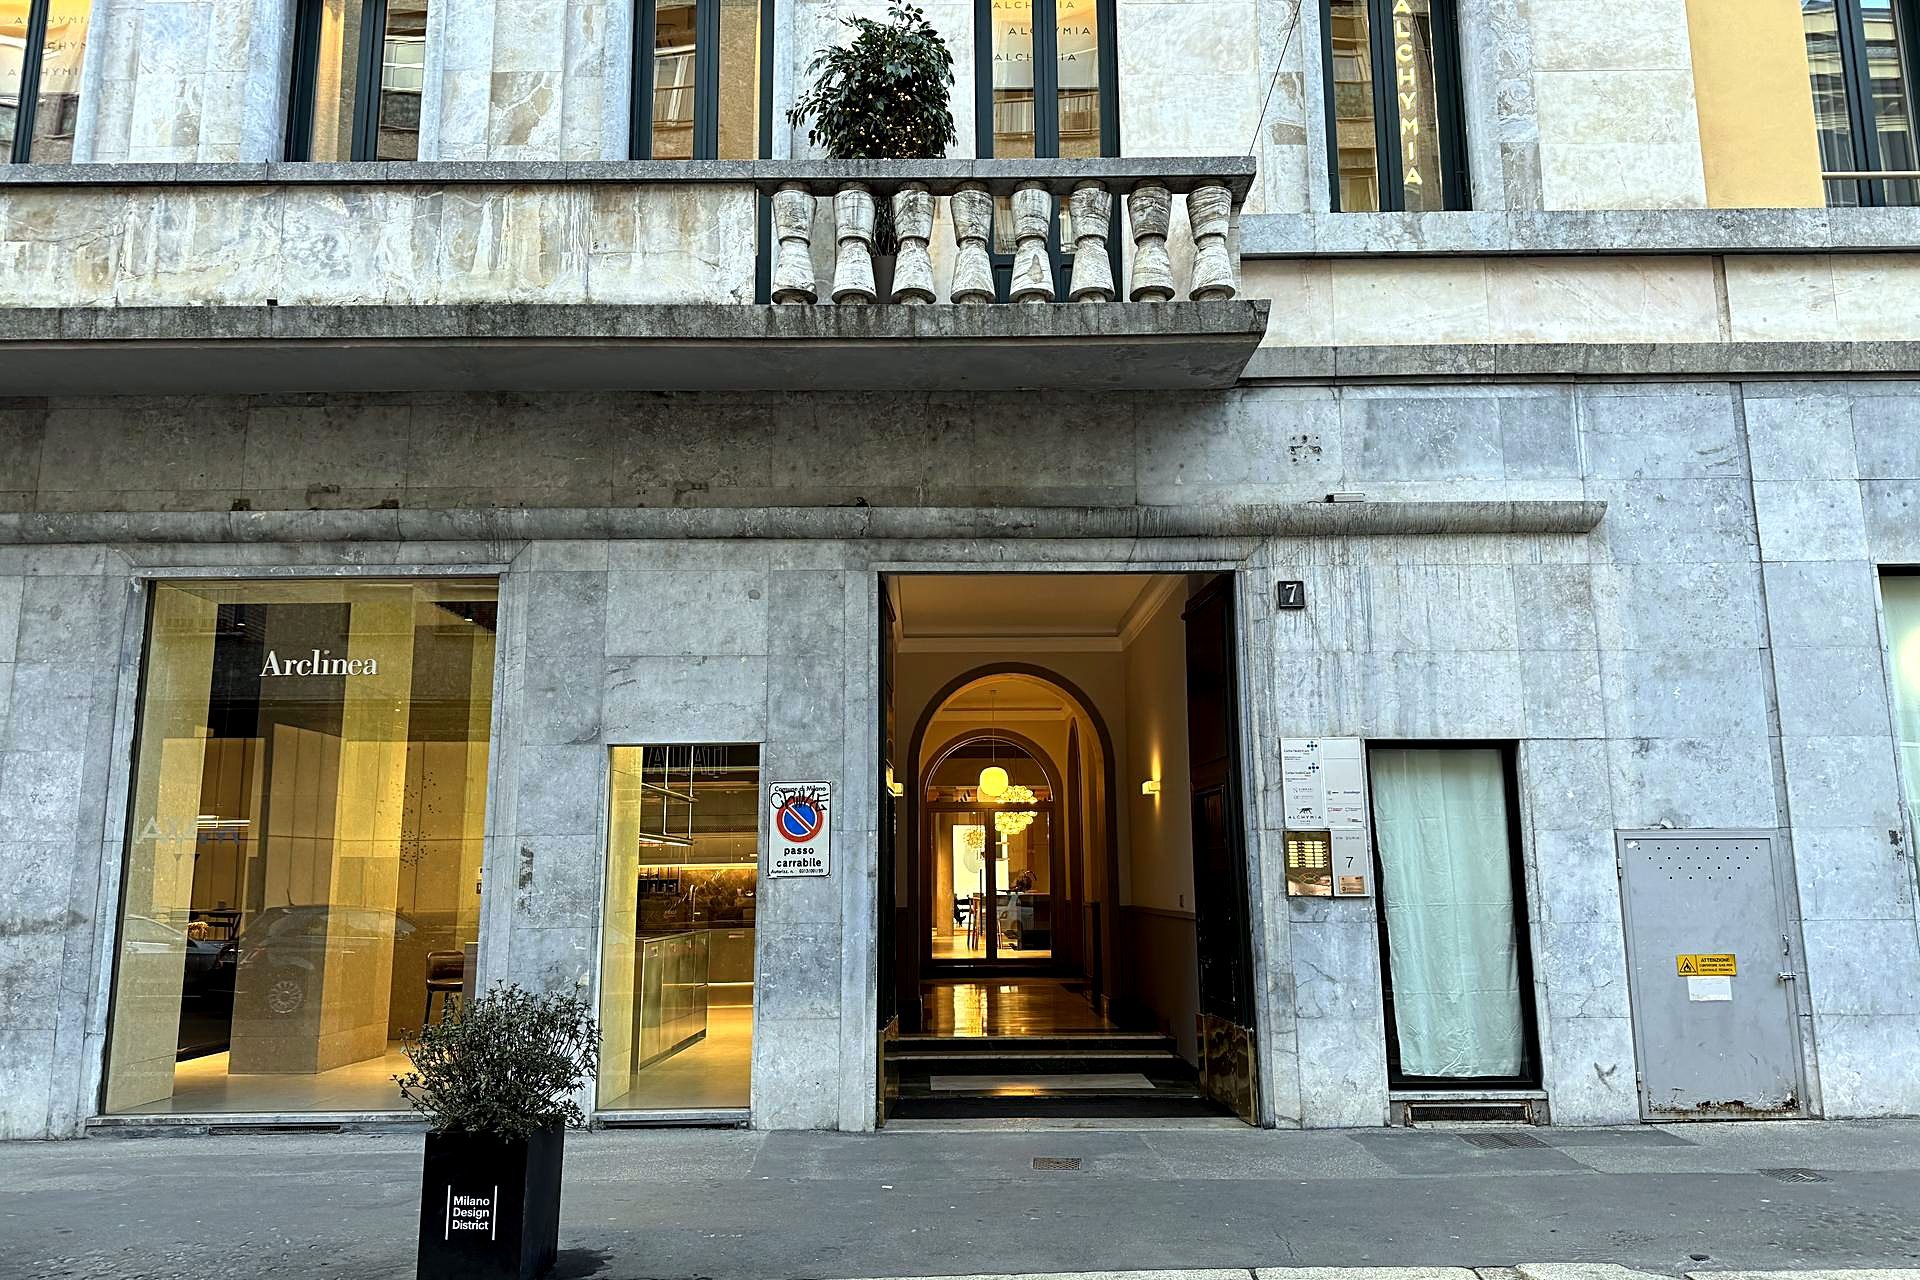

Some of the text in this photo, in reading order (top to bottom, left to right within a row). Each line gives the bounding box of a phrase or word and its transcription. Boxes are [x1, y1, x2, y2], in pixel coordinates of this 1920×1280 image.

[992, 1, 1074, 9] ALCHIA
[994, 53, 1077, 62] ALCHIA
[1392, 0, 1424, 186] ALCHYMIA
[1285, 583, 1298, 603] 7
[259, 649, 378, 676] Arclinea
[783, 847, 815, 857] passo
[776, 857, 822, 868] carrabile
[1345, 856, 1354, 868] 7
[453, 1195, 490, 1206] Milano
[453, 1206, 490, 1220] Design
[452, 1219, 489, 1230] District
